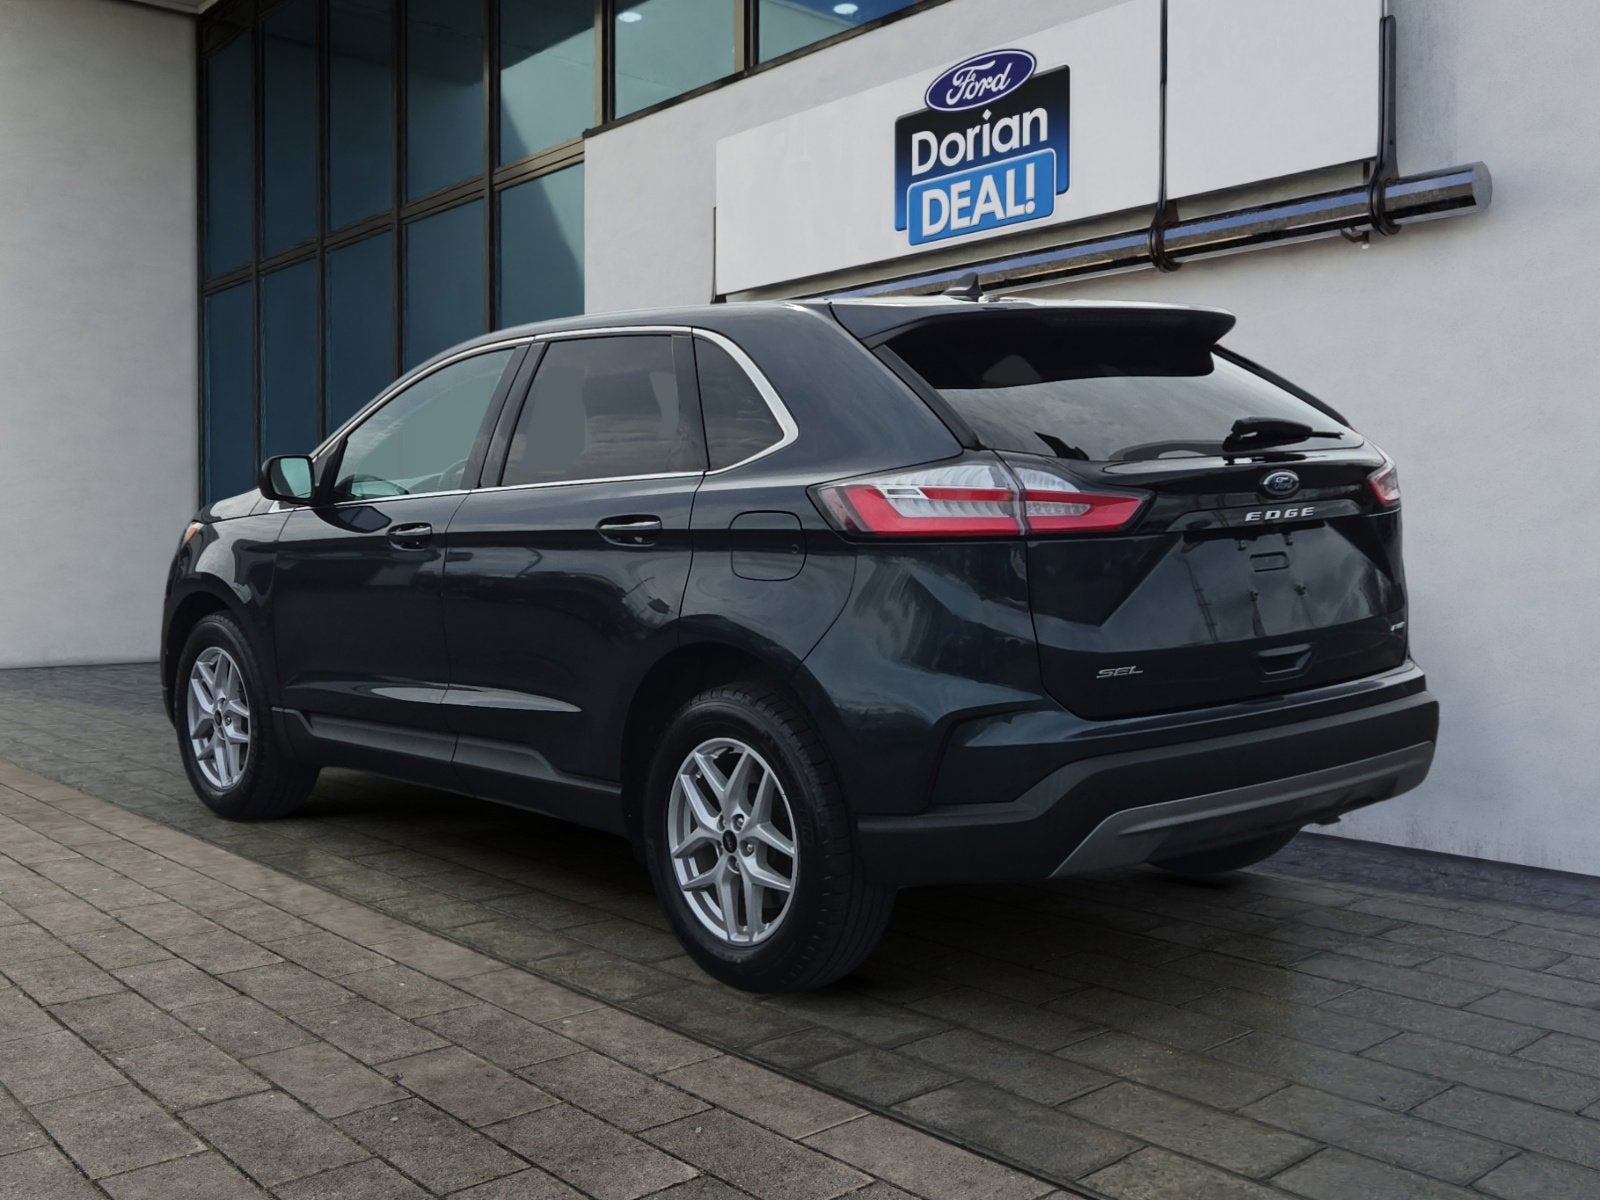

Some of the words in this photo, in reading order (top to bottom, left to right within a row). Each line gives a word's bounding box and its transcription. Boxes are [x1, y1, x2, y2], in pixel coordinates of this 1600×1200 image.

[945, 59, 1013, 106] Ford
[911, 107, 1048, 176] Dorian
[922, 162, 1036, 237] DEAL!
[1244, 506, 1315, 522] EDGE
[1096, 665, 1144, 679] SEL
